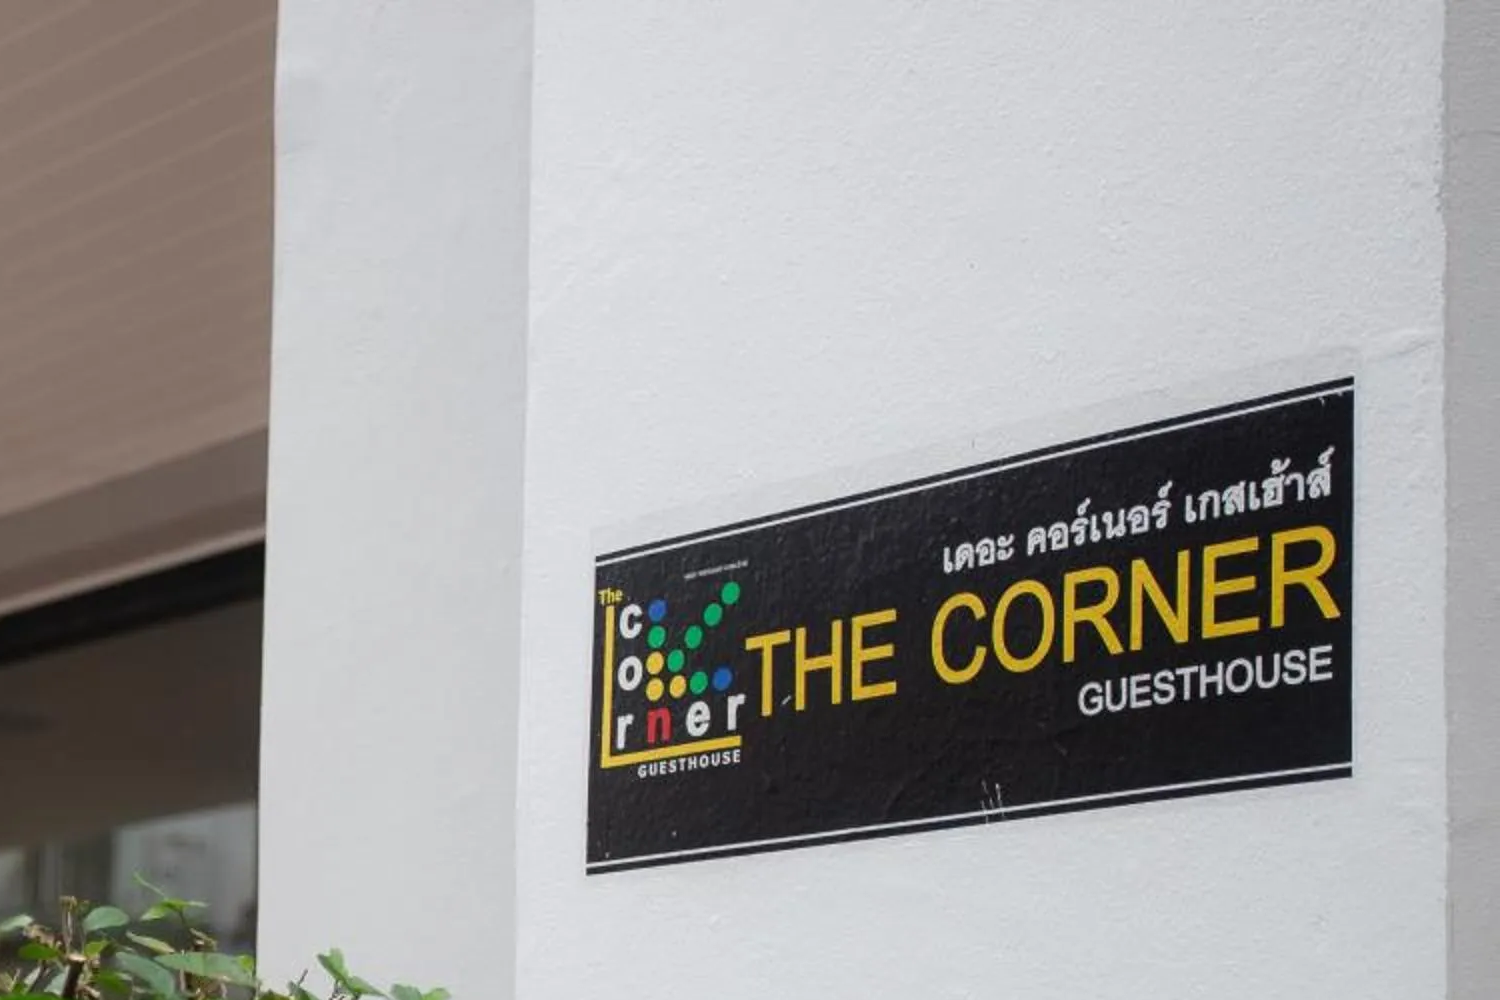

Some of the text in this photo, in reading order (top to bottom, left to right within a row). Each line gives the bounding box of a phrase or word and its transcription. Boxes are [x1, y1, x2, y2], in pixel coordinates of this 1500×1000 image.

[942, 445, 1336, 575] เดอะ คอร์เนอร์ เกสเฮ้าส์
[598, 587, 623, 605] The
[744, 523, 1342, 718] THE CORNER
[1077, 644, 1335, 717] GUESTHOUSE
[637, 749, 742, 779] GUESTHOUSE
